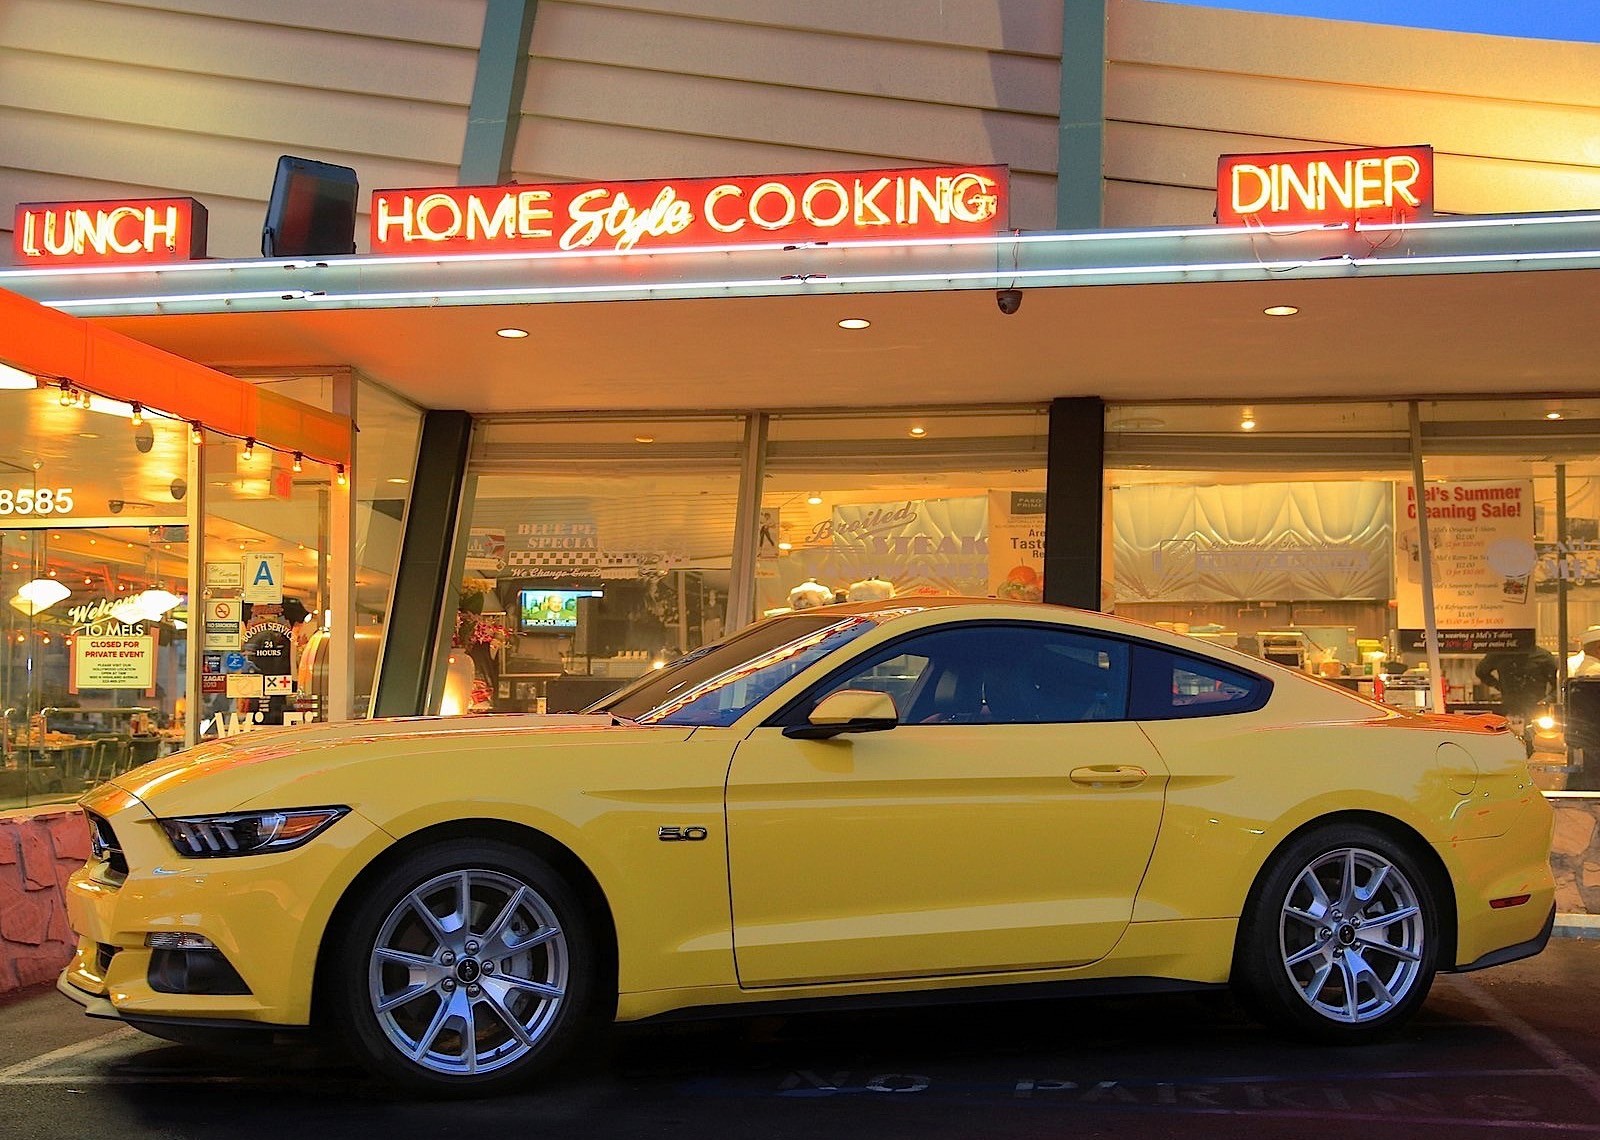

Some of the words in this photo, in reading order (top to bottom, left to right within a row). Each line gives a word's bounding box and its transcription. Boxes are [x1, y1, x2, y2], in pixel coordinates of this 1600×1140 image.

[1232, 156, 1420, 214] DINNER
[378, 190, 553, 243] HOME
[558, 185, 696, 252] Style
[703, 173, 998, 234] COOKING
[22, 205, 177, 256] LUNCH
[0, 488, 74, 515] 8585
[1454, 486, 1522, 502] Summer
[806, 501, 917, 543] Broiled
[1408, 503, 1477, 522] Ceaning
[1481, 501, 1522, 519] Sale!
[873, 536, 988, 554] STEAK
[253, 560, 275, 586] A
[529, 568, 566, 580] Change
[84, 623, 103, 636] TO
[106, 622, 144, 637] MELS
[242, 623, 267, 643] BOOTH
[657, 826, 708, 841] 5.0
[777, 1069, 933, 1094] NO
[1012, 1077, 1540, 1118] PARKING
